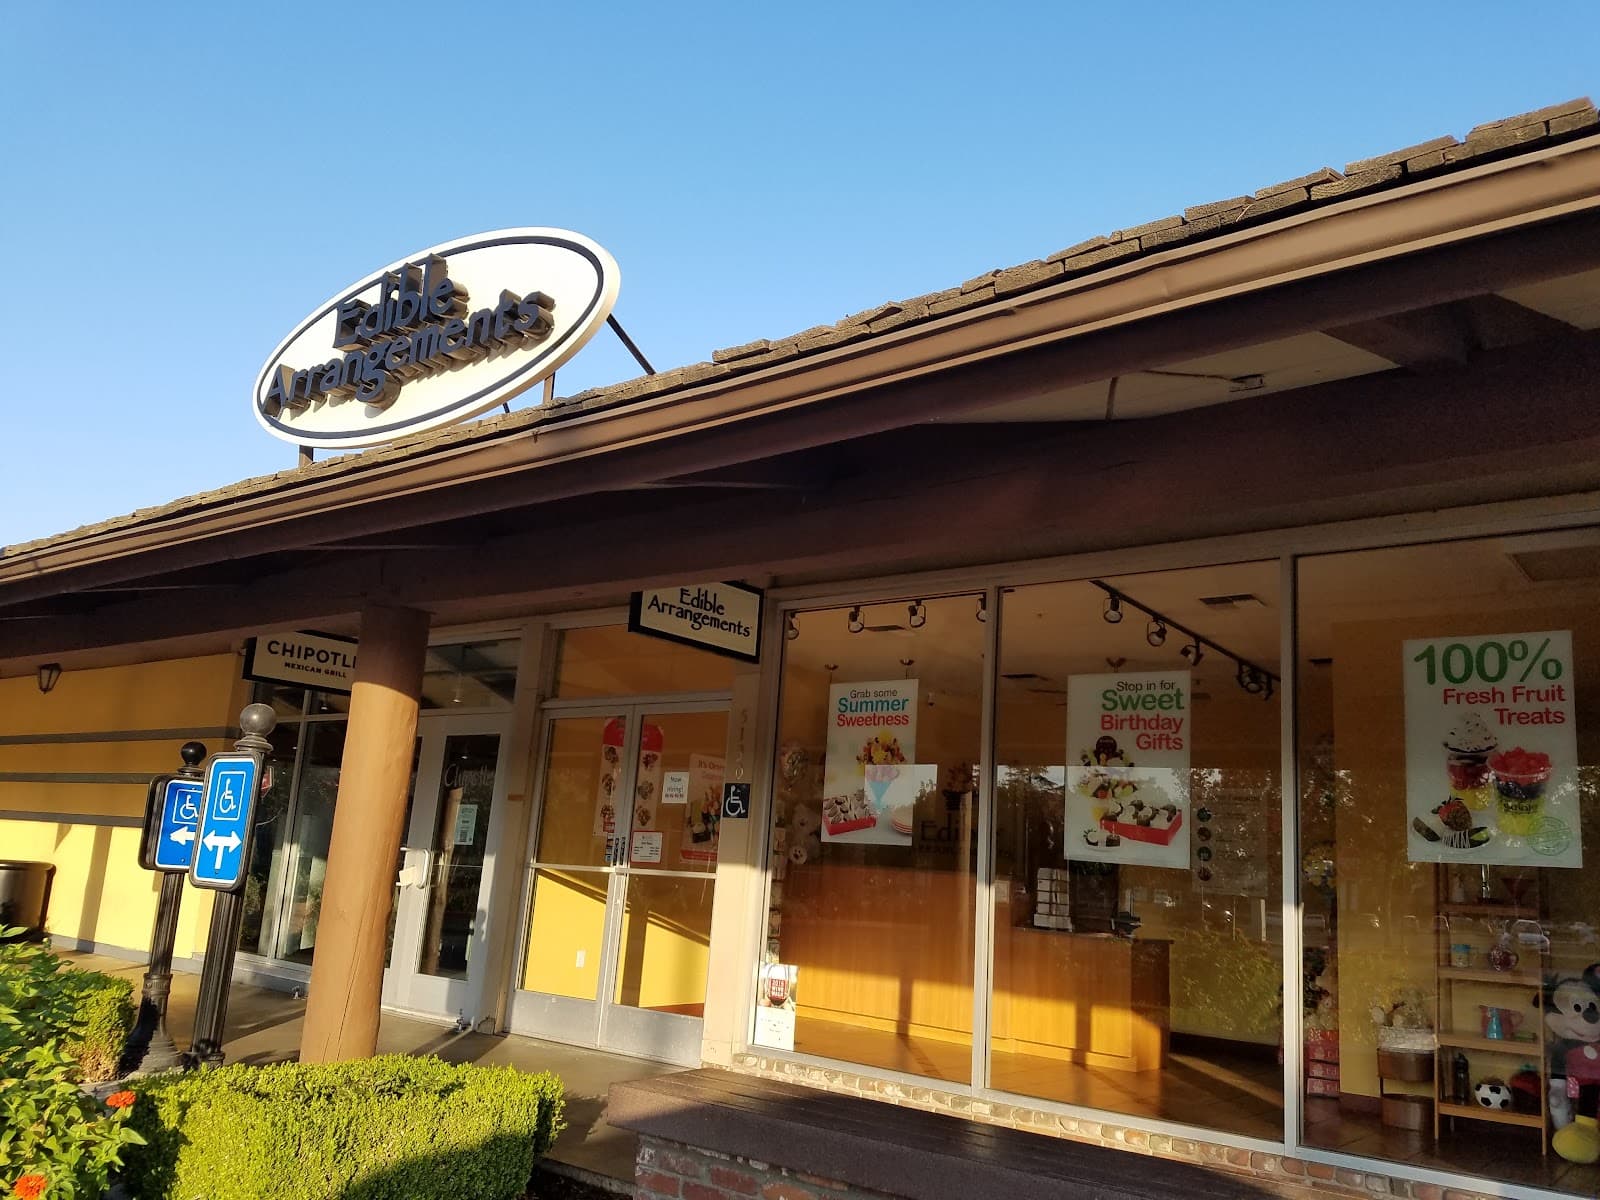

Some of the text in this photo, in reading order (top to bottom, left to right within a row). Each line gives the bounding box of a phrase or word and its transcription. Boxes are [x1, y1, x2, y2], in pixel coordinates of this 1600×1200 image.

[333, 253, 464, 349] Edible
[262, 290, 549, 406] Arrangements
[680, 588, 725, 616] Edible
[648, 595, 751, 637] Arrangements
[267, 640, 357, 669] CHIPOTL
[1414, 638, 1562, 685] 100%
[284, 662, 347, 678] MEXICAN GRILL
[850, 689, 897, 699] Grab some
[1116, 680, 1176, 693] Stop in for
[1443, 684, 1566, 705] Fresh Fruit
[838, 697, 909, 713] Summer
[1102, 688, 1185, 711] Sweet
[837, 713, 909, 727] Sweetness
[1101, 713, 1184, 735] Birthday
[1494, 708, 1565, 725] Treats
[1136, 733, 1184, 750] Gifts
